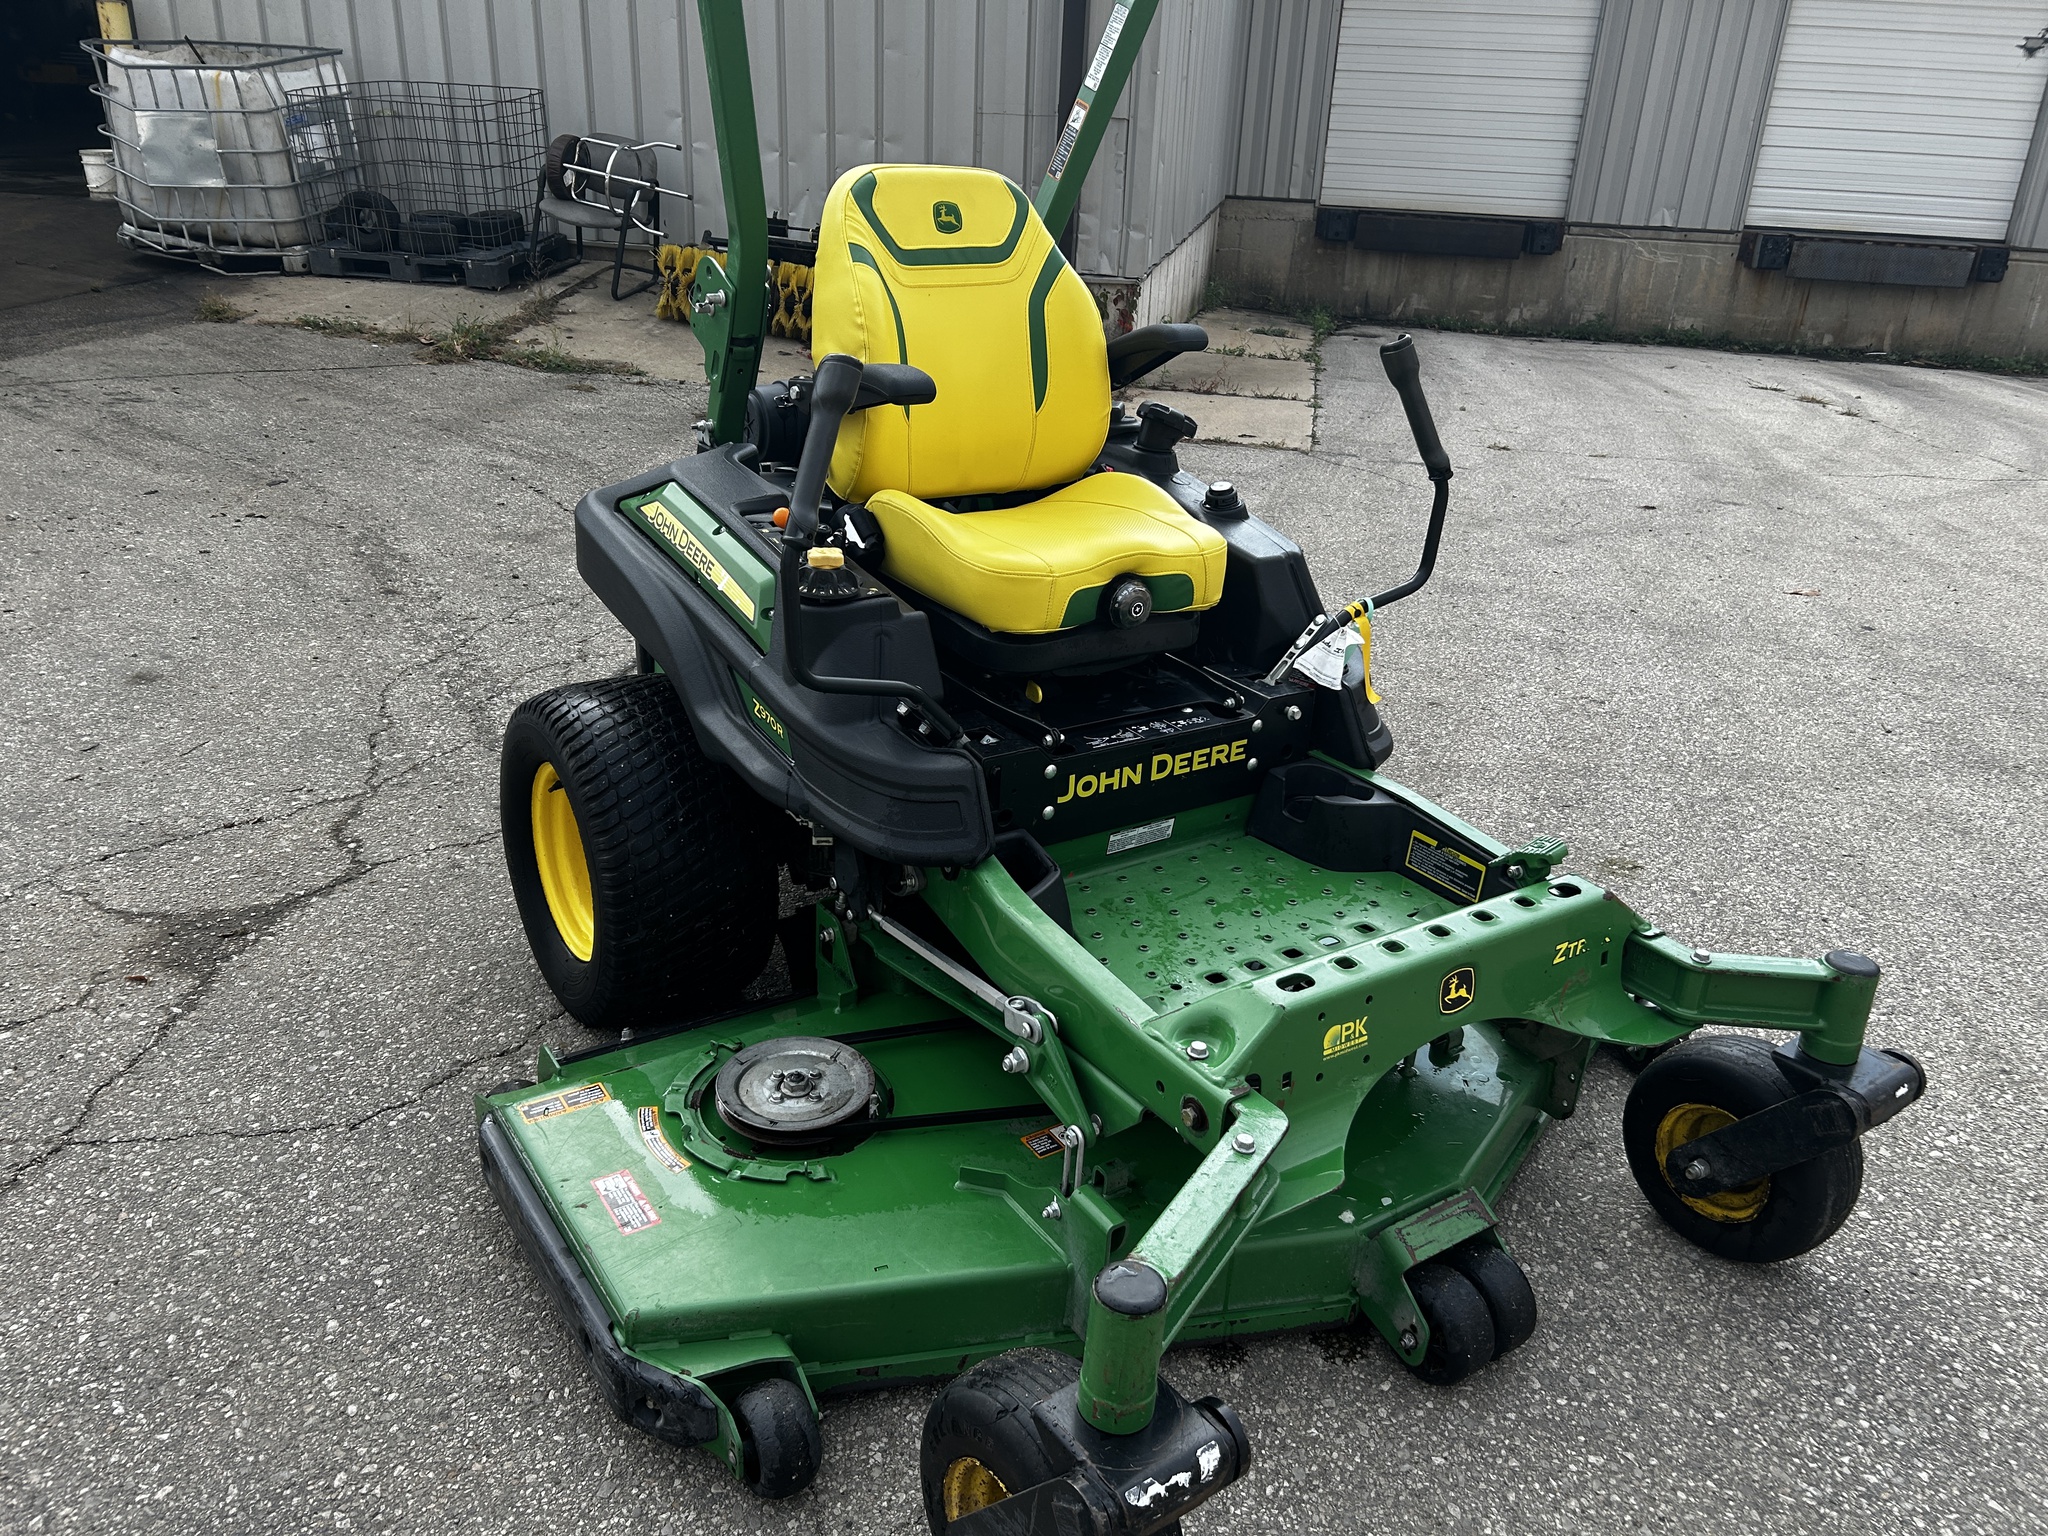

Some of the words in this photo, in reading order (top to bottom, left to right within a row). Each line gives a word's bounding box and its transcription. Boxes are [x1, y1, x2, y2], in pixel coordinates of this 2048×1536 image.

[649, 505, 680, 542] JOHN
[678, 529, 715, 578] DEERE
[752, 697, 784, 739] Z970R
[1057, 762, 1143, 804] JOHN
[1150, 738, 1249, 782] DEERE
